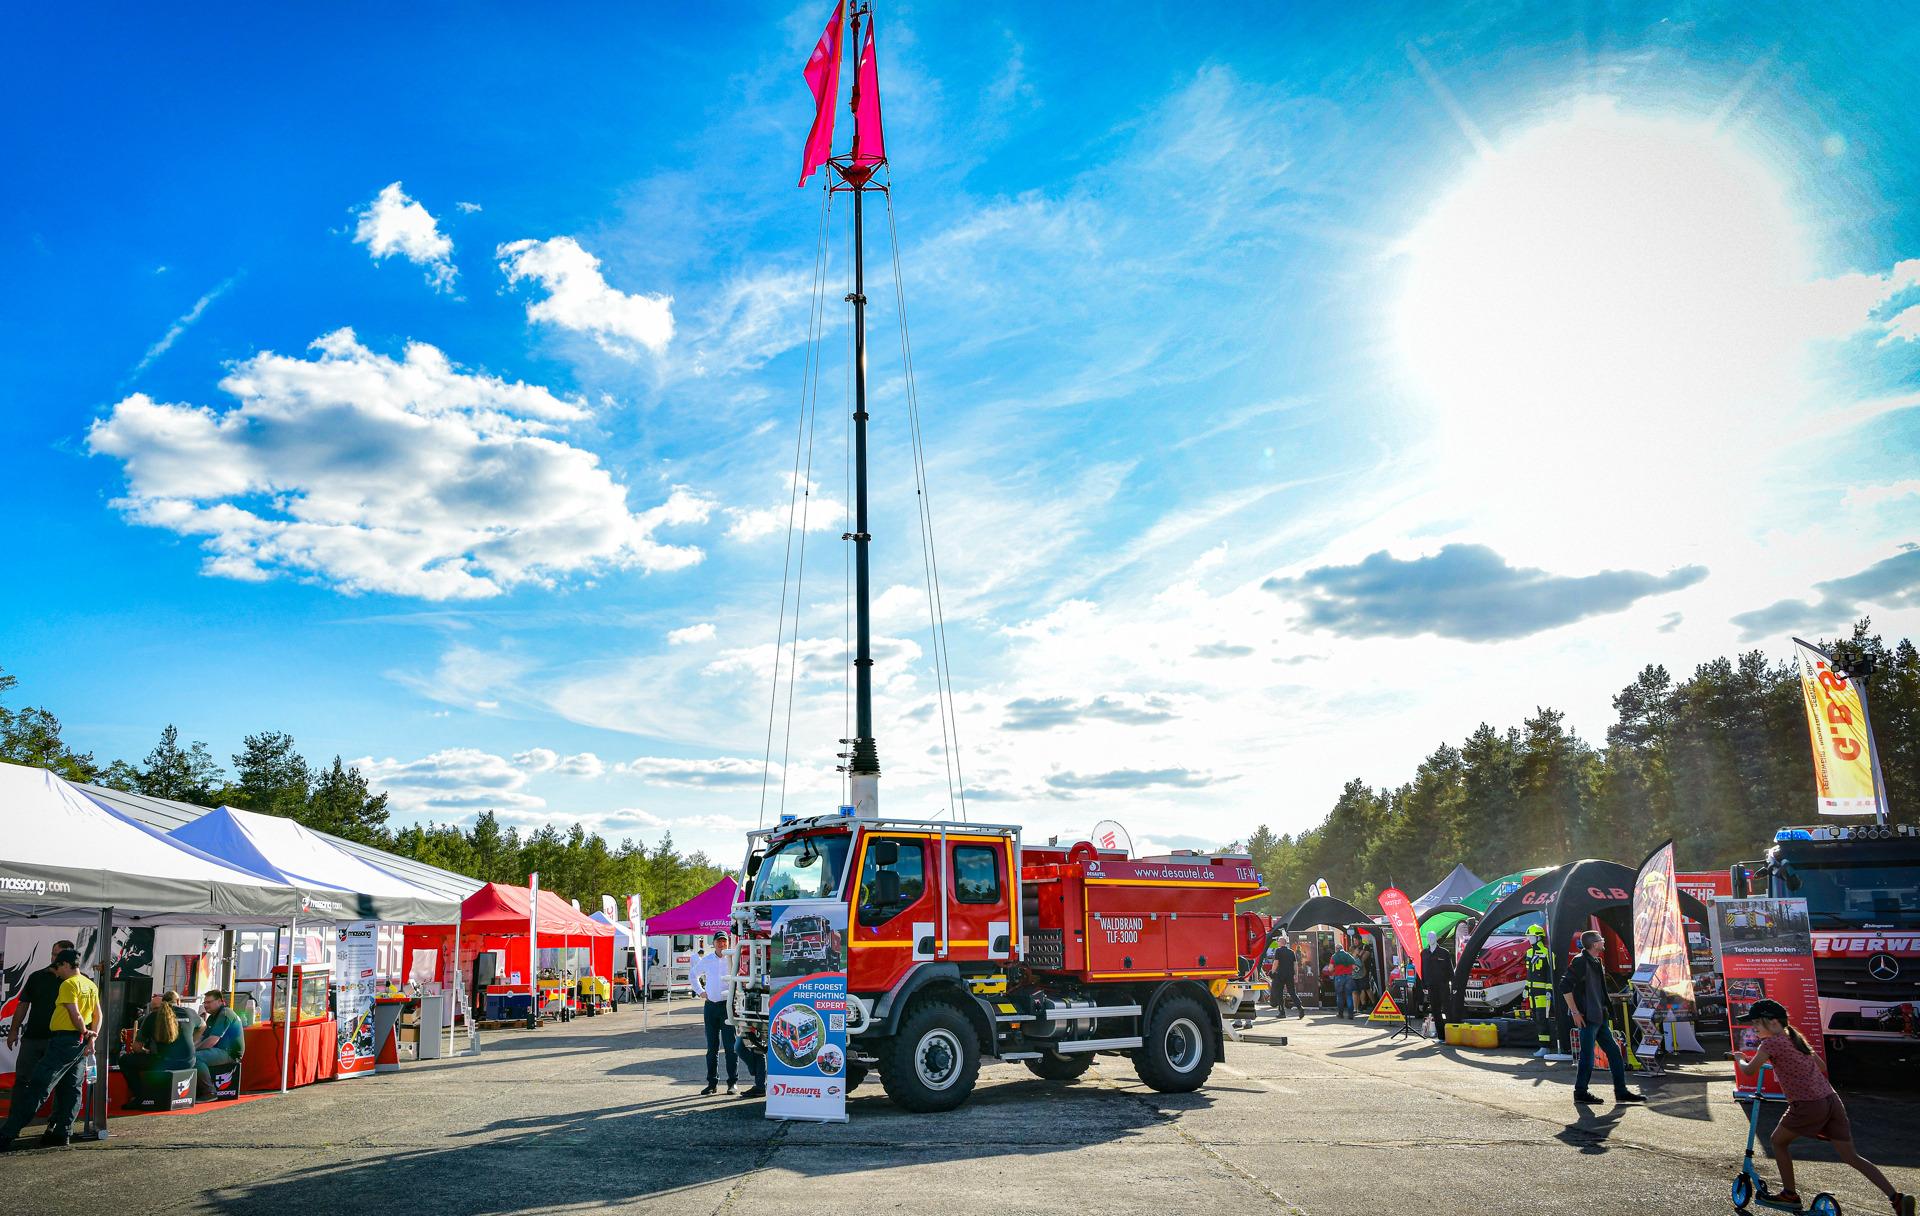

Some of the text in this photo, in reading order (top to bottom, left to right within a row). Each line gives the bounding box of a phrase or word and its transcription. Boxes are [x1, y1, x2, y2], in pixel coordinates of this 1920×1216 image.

[1134, 867, 1256, 880] www.desautel.de TLF-W
[1100, 918, 1143, 930] WALDBRAND
[1106, 931, 1138, 943] TLF-3000
[1810, 938, 1920, 951] EUERWE
[786, 1087, 822, 1095] DESAUTEL
